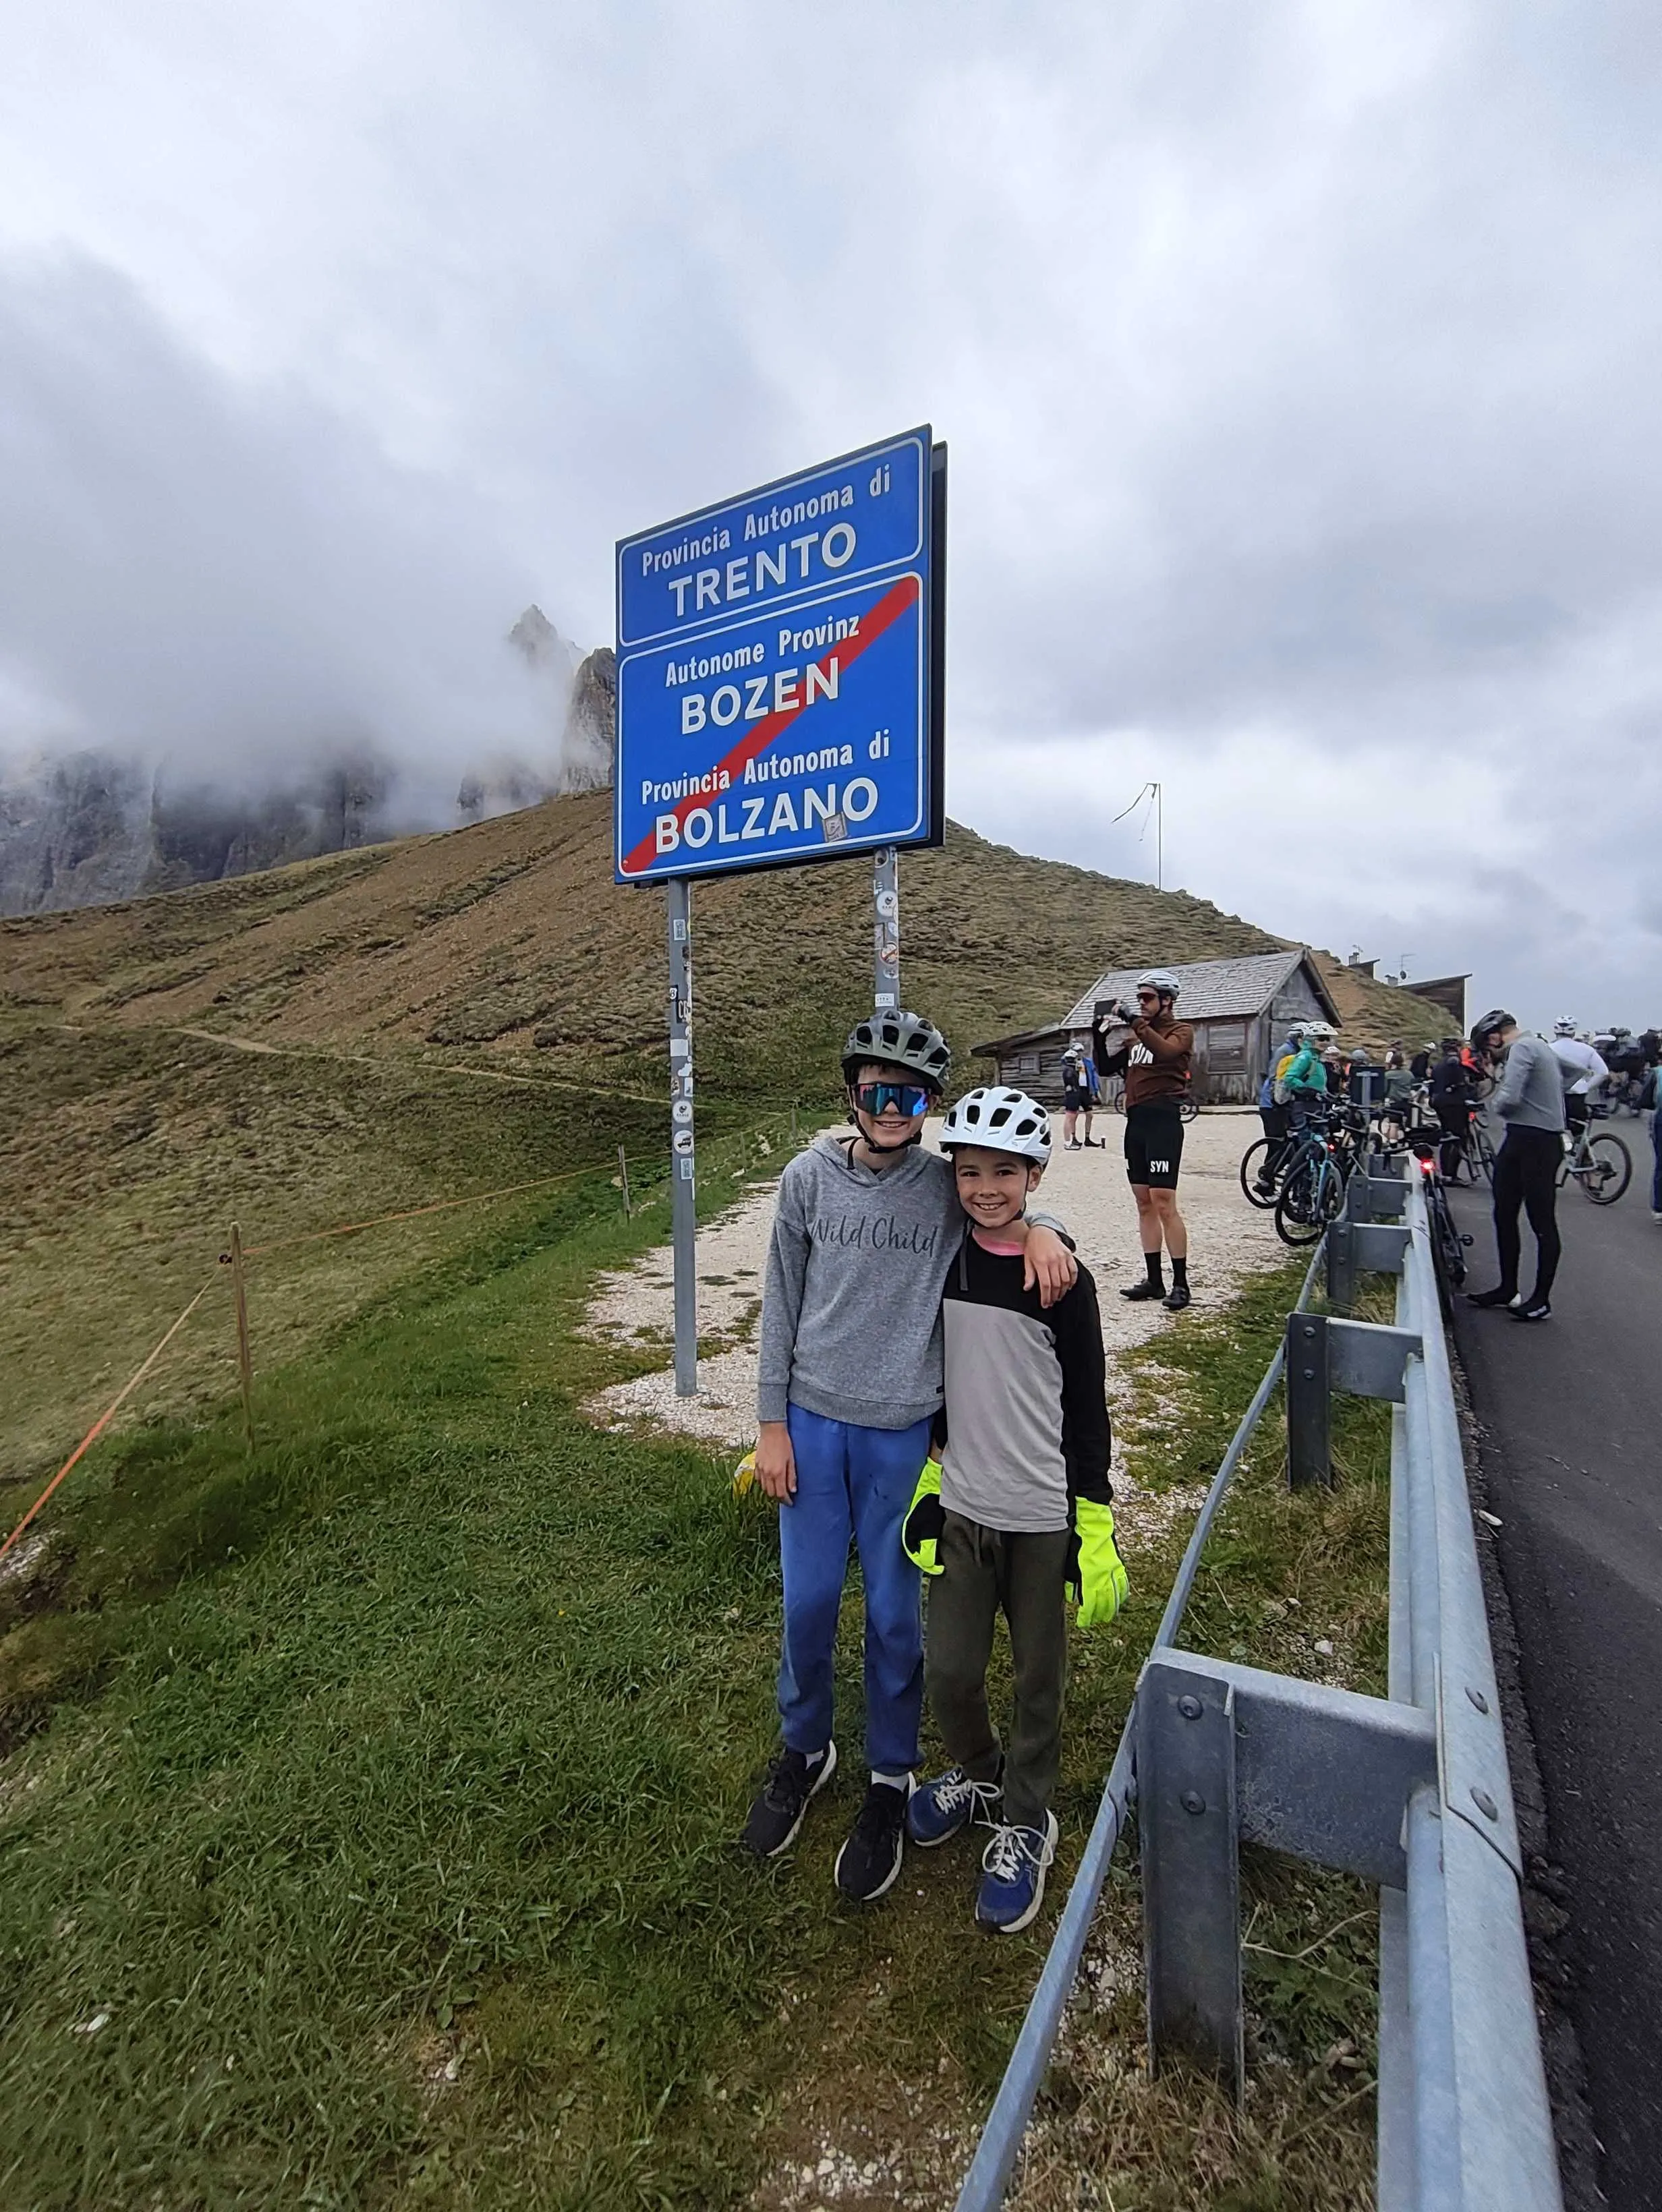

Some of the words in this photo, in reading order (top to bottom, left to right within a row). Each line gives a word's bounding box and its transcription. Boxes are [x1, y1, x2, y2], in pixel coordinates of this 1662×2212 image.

[643, 527, 730, 577] Provincia
[744, 485, 853, 540] Autonoma
[869, 464, 890, 497] di
[668, 523, 856, 616] TRENTO
[666, 643, 764, 687] Autonome
[779, 615, 859, 656] Provinz
[681, 657, 839, 734] BOZEN
[642, 765, 730, 805] Provincia
[743, 745, 853, 784] Autonoma
[869, 729, 889, 760] di
[655, 777, 878, 854] BOLZANO
[1150, 1161, 1169, 1173] SYN
[811, 1215, 866, 1248] Wild
[872, 1215, 938, 1258] Child
